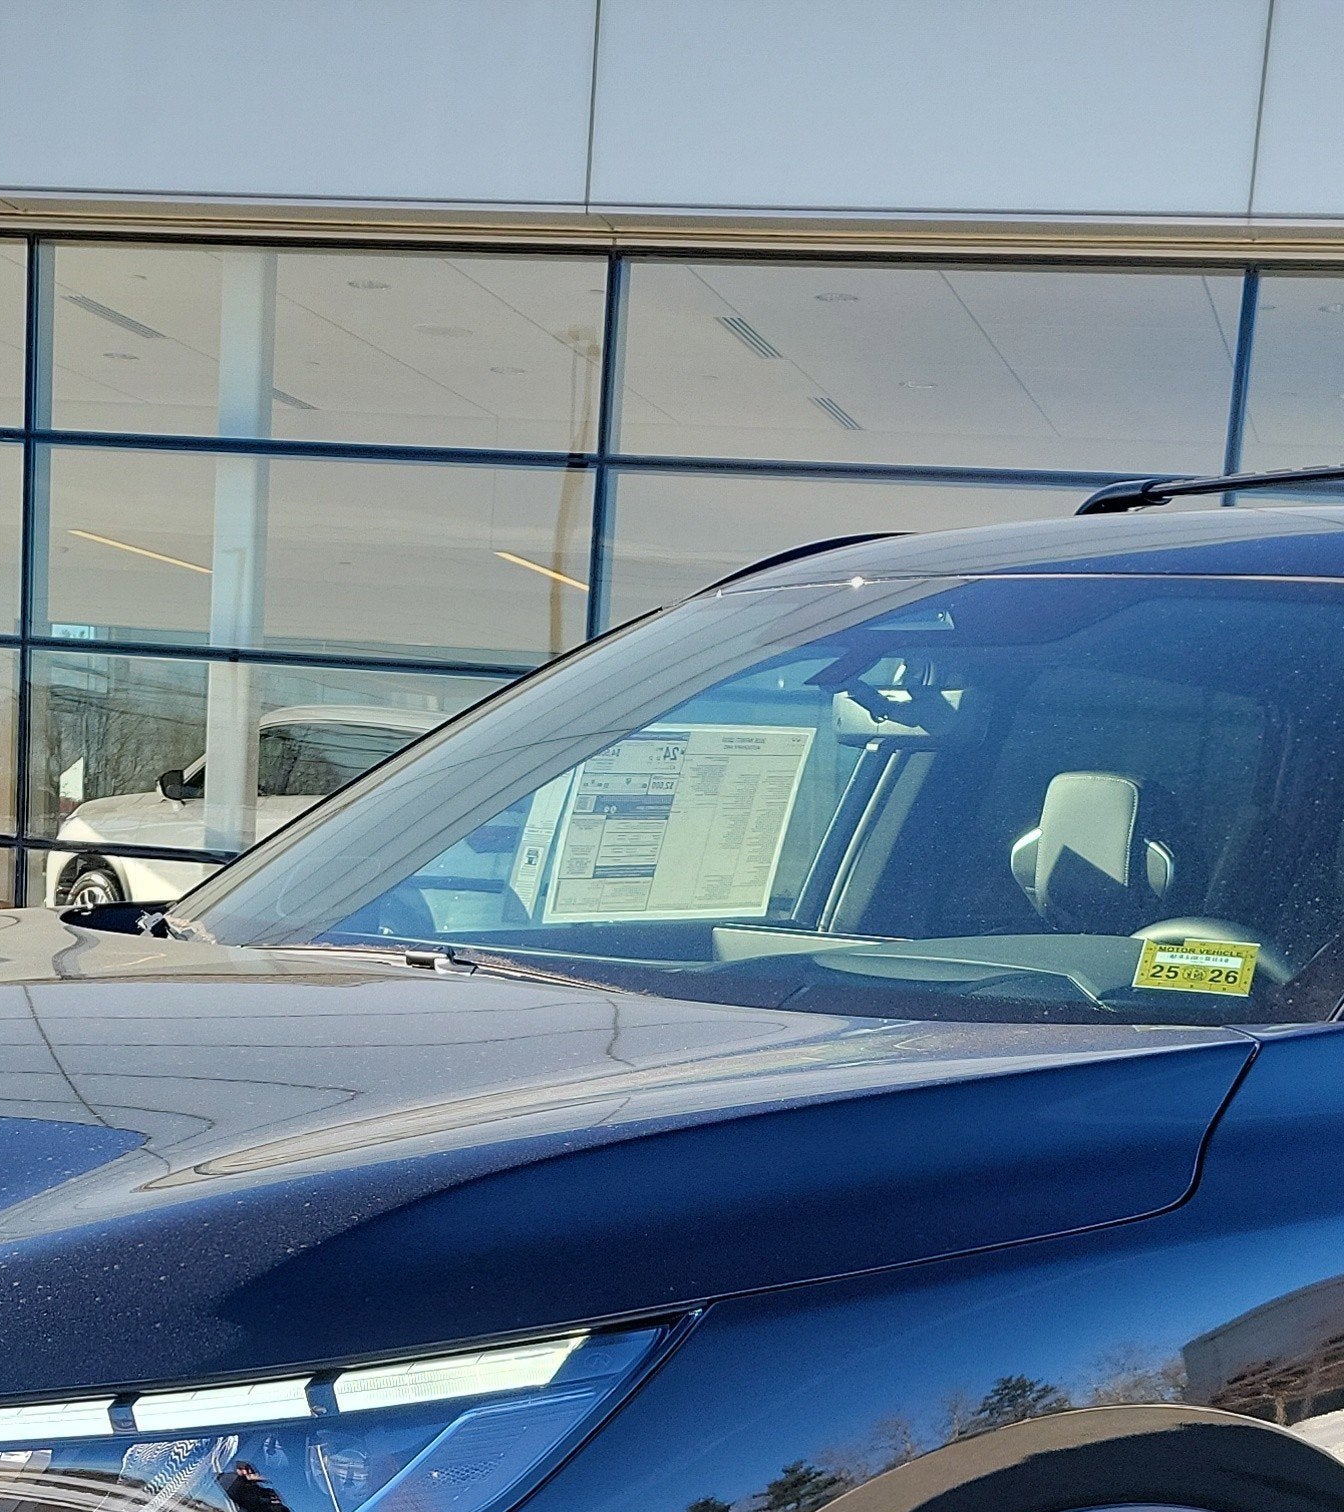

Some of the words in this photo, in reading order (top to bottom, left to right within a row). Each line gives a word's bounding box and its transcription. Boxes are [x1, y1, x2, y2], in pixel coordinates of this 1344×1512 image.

[1158, 945, 1196, 954] MOTOR
[1199, 948, 1244, 958] VEHICLE
[1149, 964, 1179, 980] 25
[1207, 968, 1239, 985] 26
